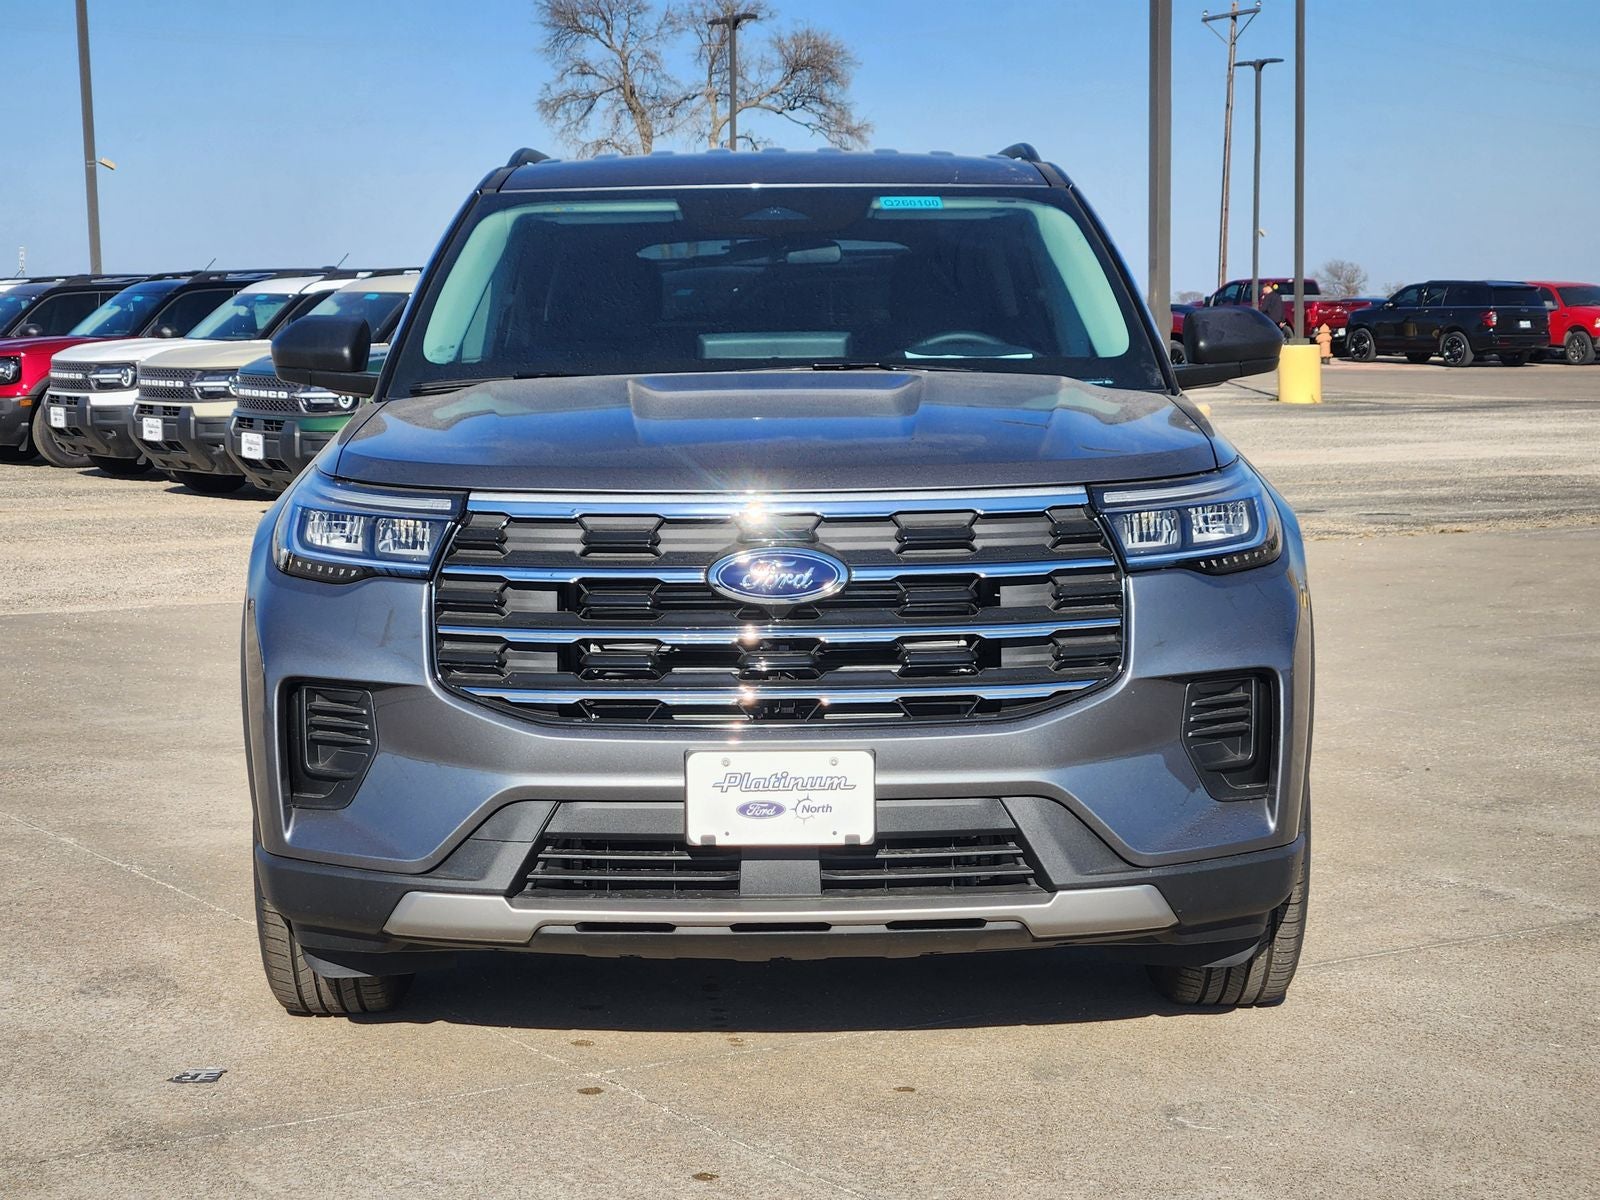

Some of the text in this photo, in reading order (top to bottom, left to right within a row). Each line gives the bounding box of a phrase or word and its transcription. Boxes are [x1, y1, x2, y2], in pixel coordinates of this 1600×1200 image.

[883, 199, 939, 207] Q260100
[140, 379, 184, 388] BRONCO
[238, 388, 288, 399] BRONCO
[740, 558, 815, 592] Ford
[712, 771, 856, 793] Platinum
[746, 803, 832, 817] Ford North
